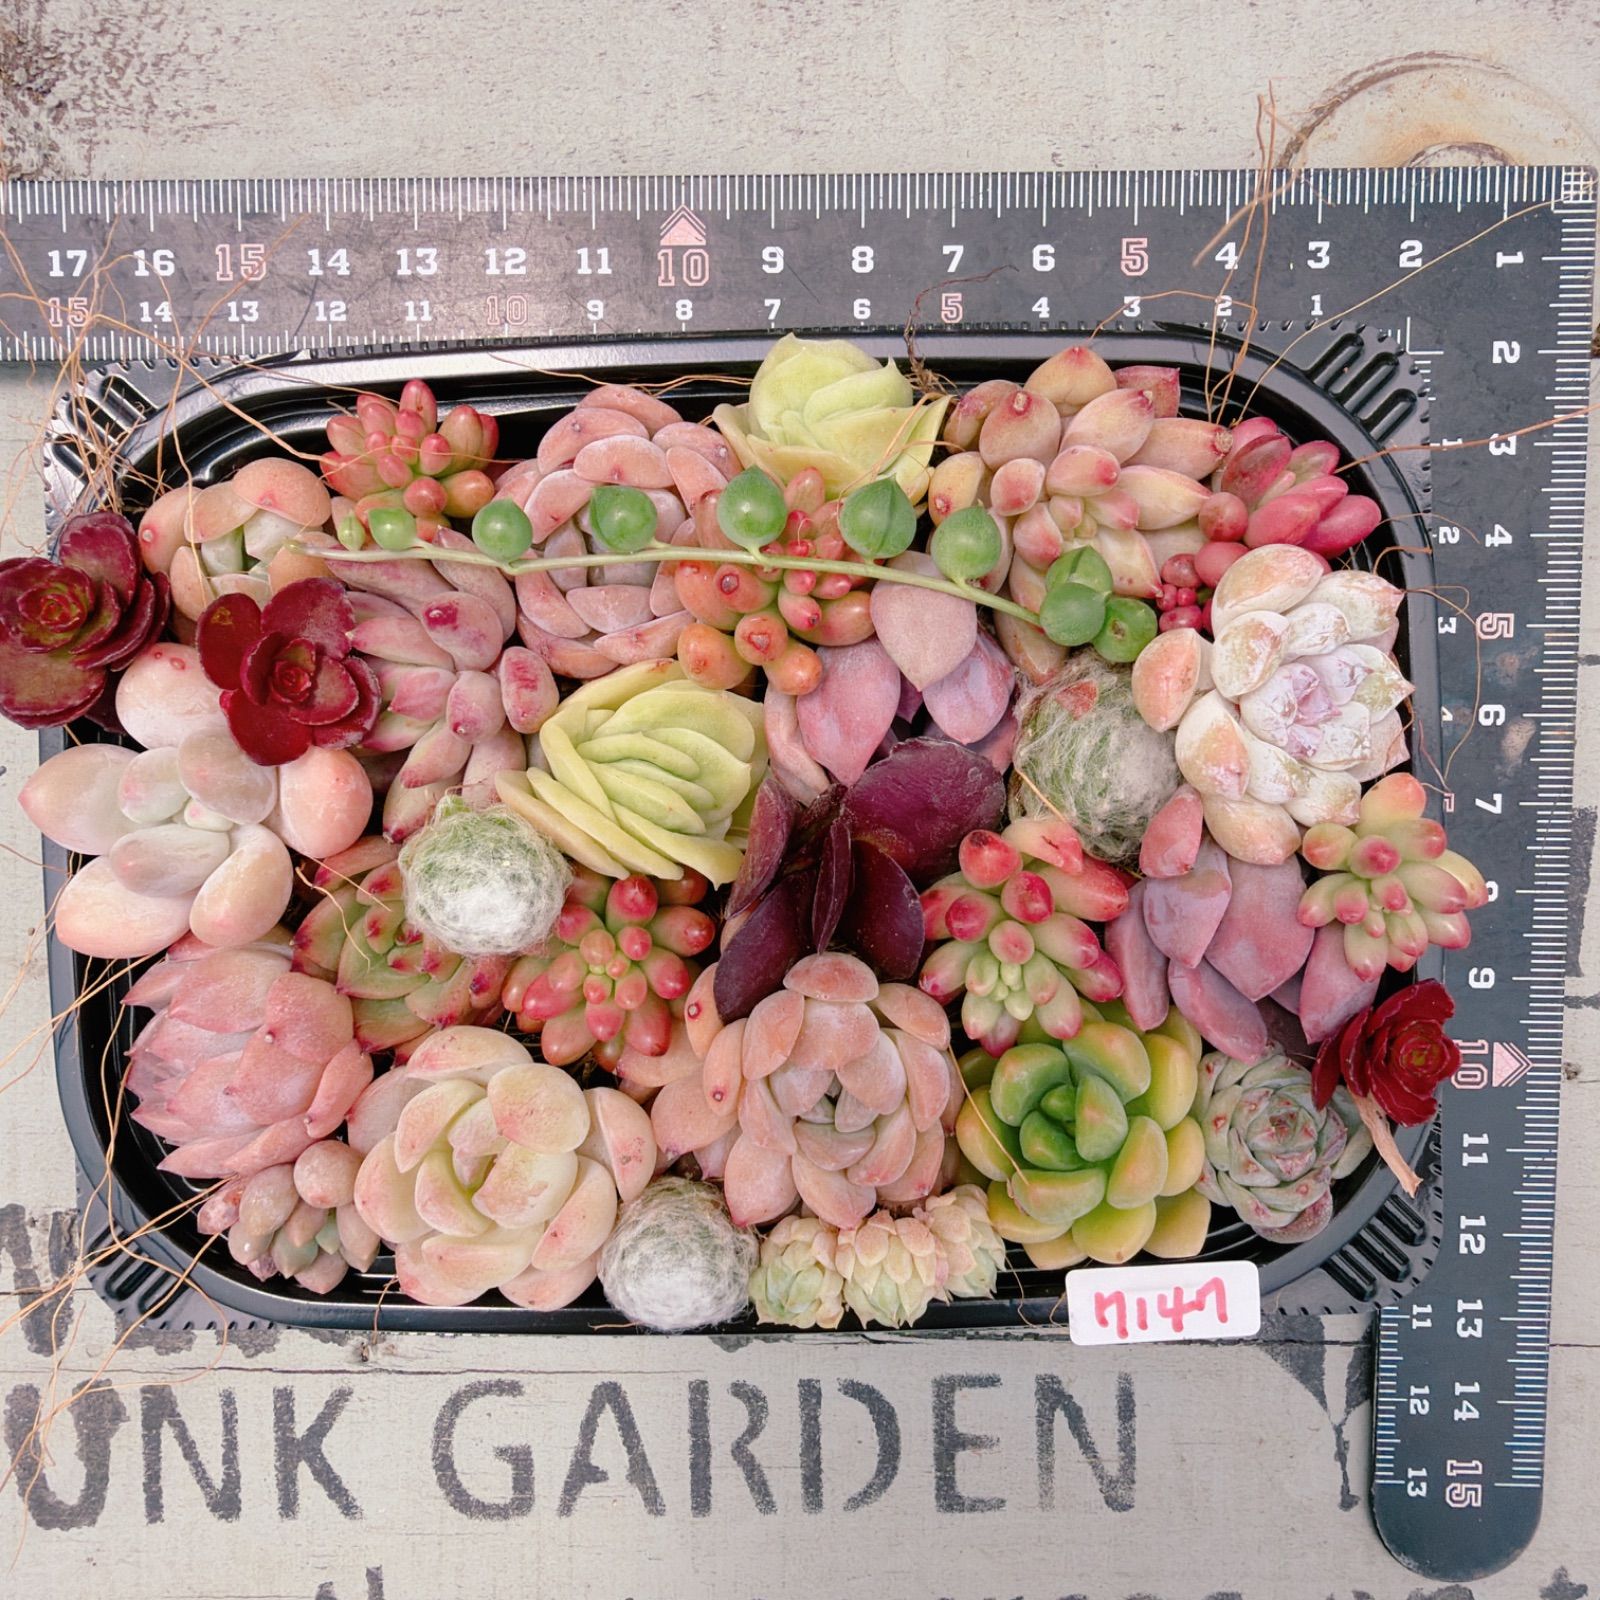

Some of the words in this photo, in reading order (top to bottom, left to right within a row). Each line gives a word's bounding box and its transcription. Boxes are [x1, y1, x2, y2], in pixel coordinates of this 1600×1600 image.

[48, 250, 87, 277] 17
[134, 250, 174, 276] 16
[216, 244, 266, 281] 15
[308, 249, 350, 275] 14
[397, 248, 438, 275] 13
[485, 248, 526, 275] 12
[577, 248, 612, 274] 11
[658, 249, 709, 286] 10
[763, 247, 783, 273] 9
[852, 246, 873, 273] 8
[943, 245, 963, 272] 7
[1033, 245, 1055, 271] 6
[1121, 238, 1148, 276] 5
[1215, 242, 1238, 269] 4
[1308, 241, 1329, 268] 3
[1400, 240, 1423, 267] 2
[1496, 251, 1524, 268] 1
[49, 297, 88, 326] 15
[140, 301, 173, 322] 14
[228, 301, 258, 322] 13
[315, 301, 346, 321] 12
[405, 301, 432, 321] 11
[487, 296, 528, 325] 10
[587, 300, 603, 320] 9
[676, 300, 692, 320] 8
[765, 299, 780, 319] 7
[854, 299, 870, 319] 6
[941, 293, 962, 323] 5
[1032, 297, 1049, 318] 4
[1123, 296, 1141, 317] 3
[1216, 295, 1232, 316] 2
[1311, 295, 1323, 315] 1
[1493, 341, 1520, 363] 2
[1489, 433, 1517, 456] 3
[1439, 527, 1459, 543] 2
[1486, 524, 1512, 547] 4
[1438, 617, 1456, 633] 3
[1475, 613, 1514, 639] 5
[1479, 705, 1505, 725] 6
[1476, 794, 1502, 814] 7
[1469, 968, 1495, 988] 9
[1451, 1040, 1488, 1089] 10
[1463, 1134, 1488, 1166] 11
[1460, 1216, 1486, 1254] 12
[1413, 1305, 1432, 1329] 11
[1457, 1300, 1483, 1337] 13
[1410, 1386, 1429, 1414] 12
[1454, 1382, 1480, 1420] 14
[432, 1372, 1136, 1519] GARDEN
[1408, 1468, 1427, 1496] 13
[1446, 1460, 1482, 1507] 15
